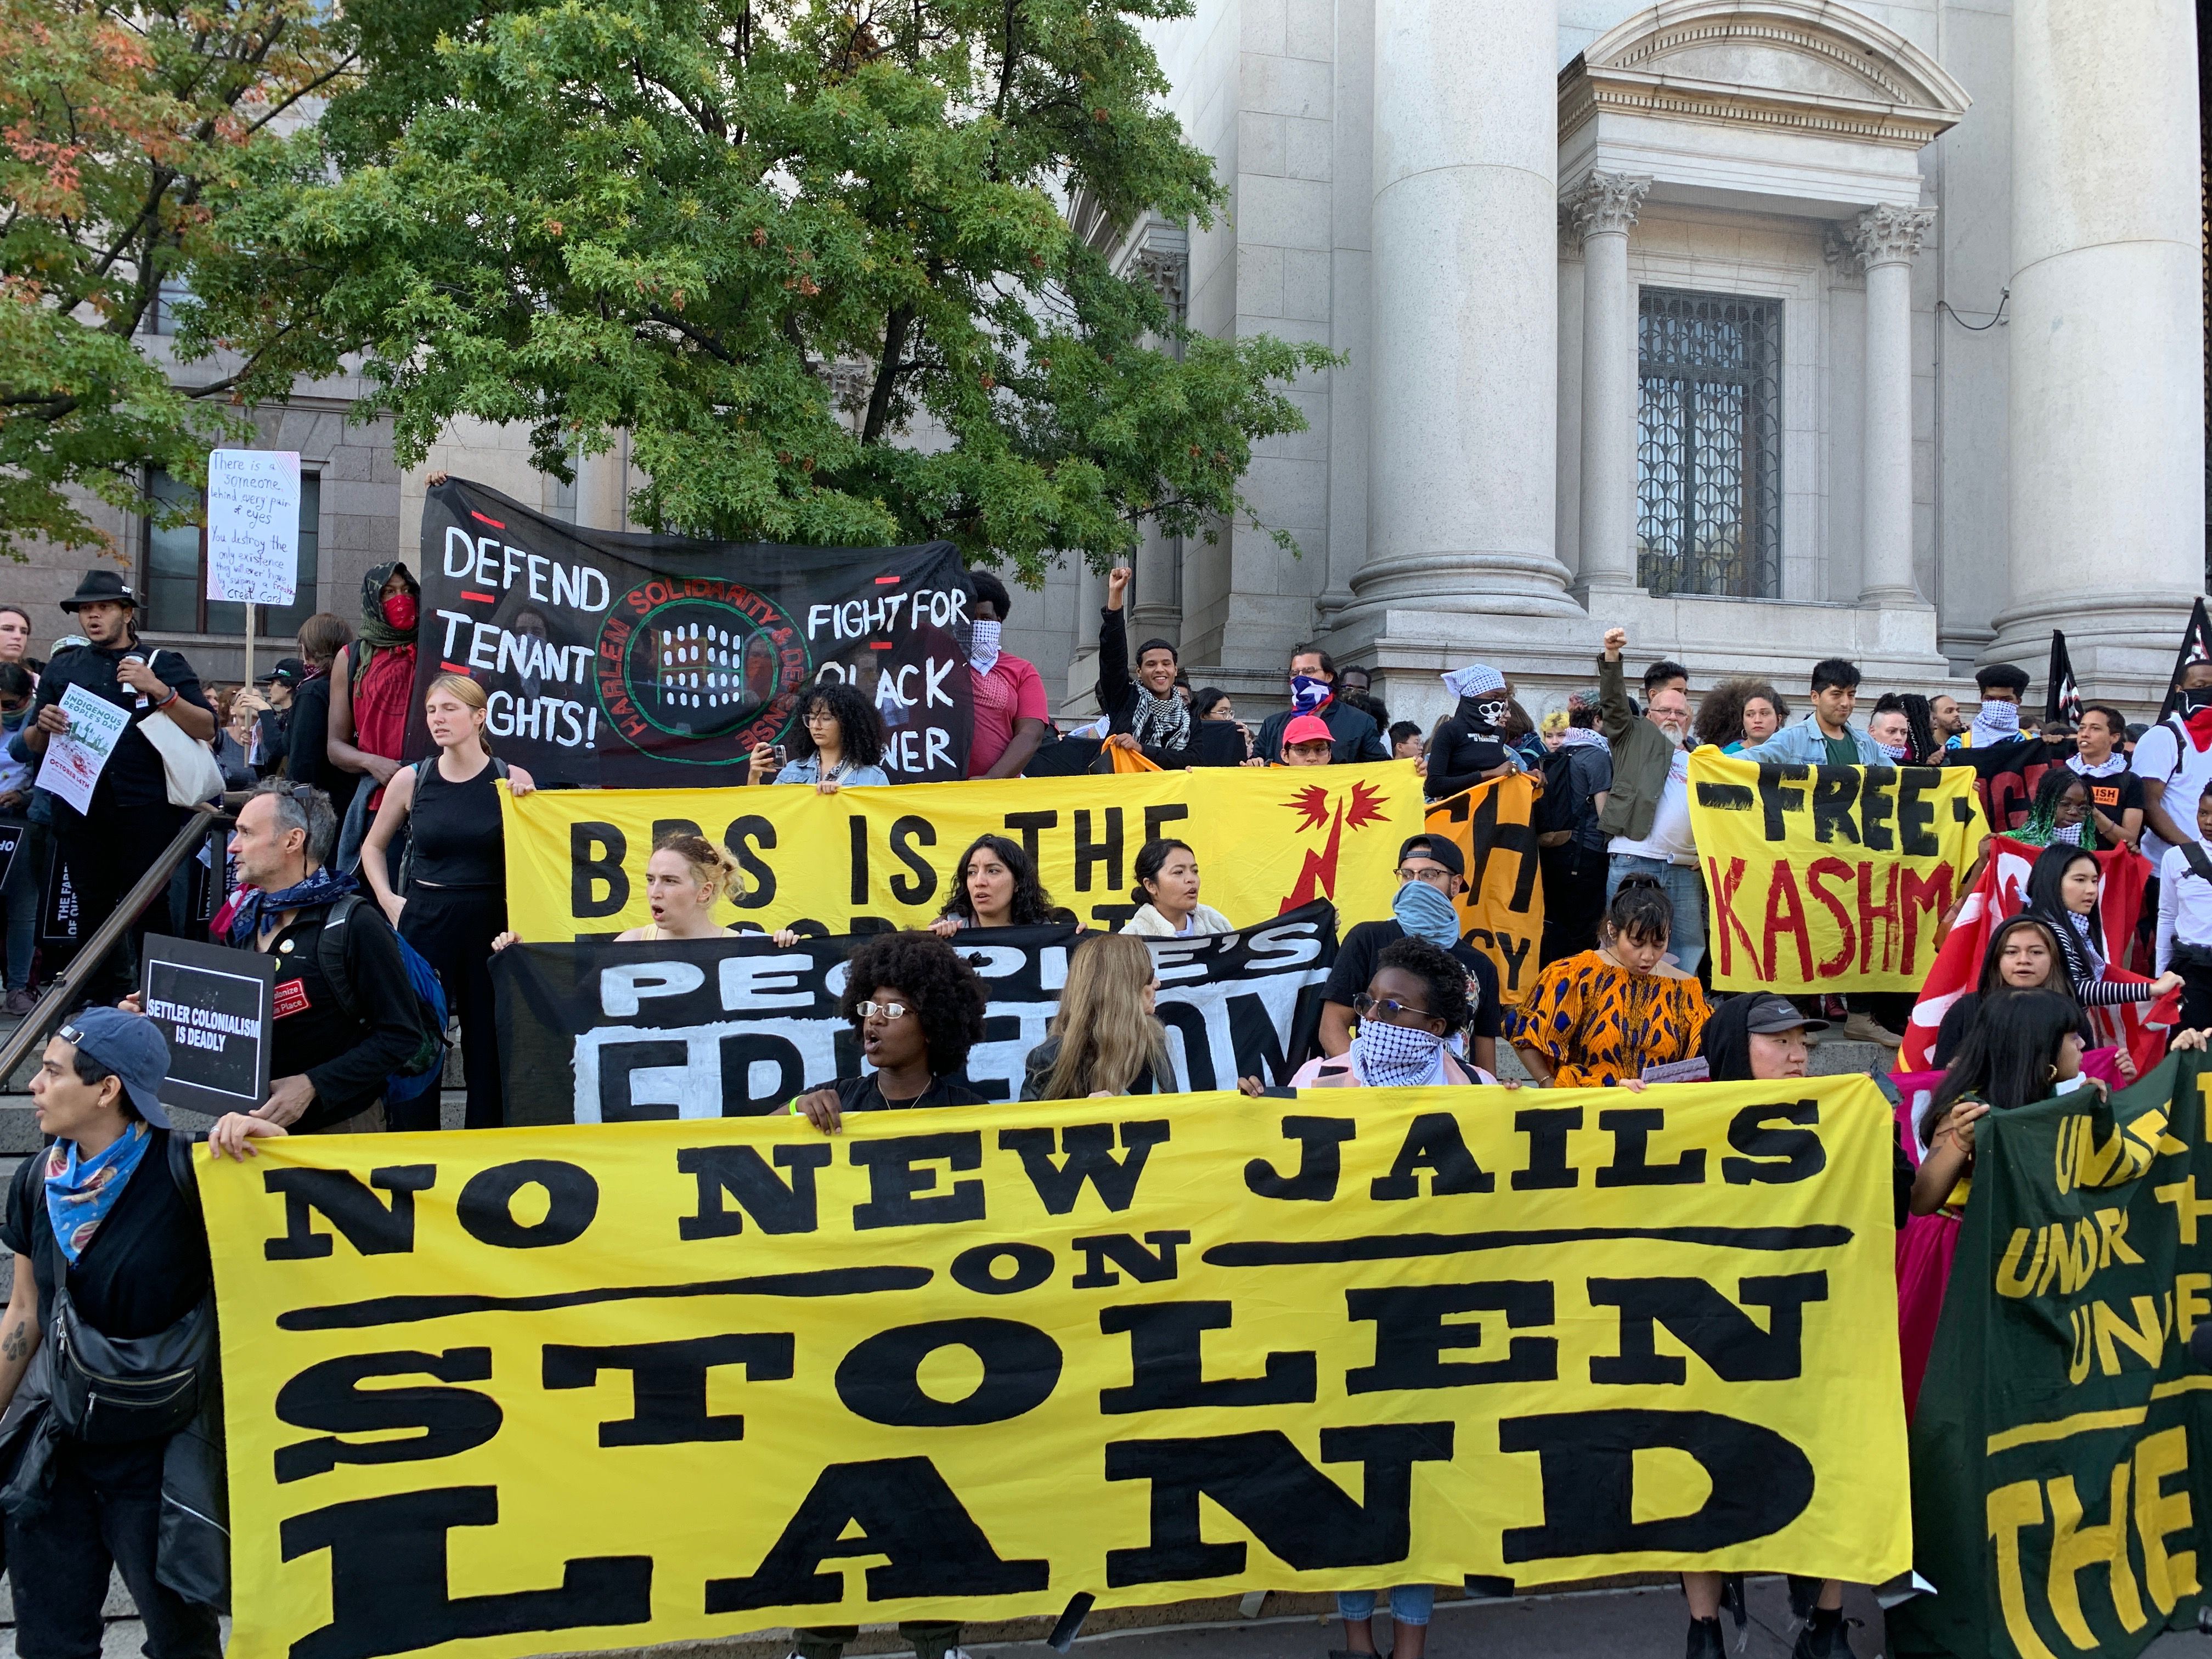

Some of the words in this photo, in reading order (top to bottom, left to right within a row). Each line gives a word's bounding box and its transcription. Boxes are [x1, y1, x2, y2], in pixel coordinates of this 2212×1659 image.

[213, 452, 245, 470] There
[251, 460, 261, 471] is
[211, 487, 237, 501] behind
[270, 496, 291, 513] pair
[247, 509, 272, 528] eyes
[212, 525, 226, 541] You
[232, 528, 265, 554] destroy
[270, 534, 288, 552] the
[219, 546, 235, 565] only
[216, 562, 230, 577] they
[443, 525, 611, 613] DEFEND
[808, 592, 909, 641] FIGHT
[910, 588, 970, 630] FOR
[436, 609, 595, 686] TENANT
[601, 617, 648, 739] HARLEM
[628, 577, 782, 627] SOLIDARITY
[63, 700, 101, 723] PEOPLE'S
[101, 720, 119, 731] DAY
[66, 693, 122, 726] INDIGENOUS
[486, 690, 597, 749] GHTS!
[879, 726, 957, 772] WER
[50, 759, 76, 780] OCTOBER
[76, 776, 90, 789] 14TH
[1758, 763, 1942, 856] FREE
[849, 814, 938, 906] IS
[58, 898, 70, 921] THE
[1707, 856, 1955, 983] KASHM
[600, 922, 1322, 1017] PEPLE'S
[274, 986, 298, 1000] olonize
[280, 1000, 303, 1012] Place
[148, 998, 190, 1024] SETTLER
[191, 1008, 259, 1039] COLONIALISM
[175, 1025, 187, 1043] IS
[187, 1028, 226, 1053] DEADLY
[264, 1158, 600, 1261] NO
[677, 1119, 1171, 1242] NEW
[1243, 1099, 1827, 1202] JAILS
[950, 1229, 1191, 1295] ON
[274, 1269, 1829, 1484] STOLEN
[280, 1407, 1815, 1659] LAND
[1987, 1425, 2202, 1659] THE
